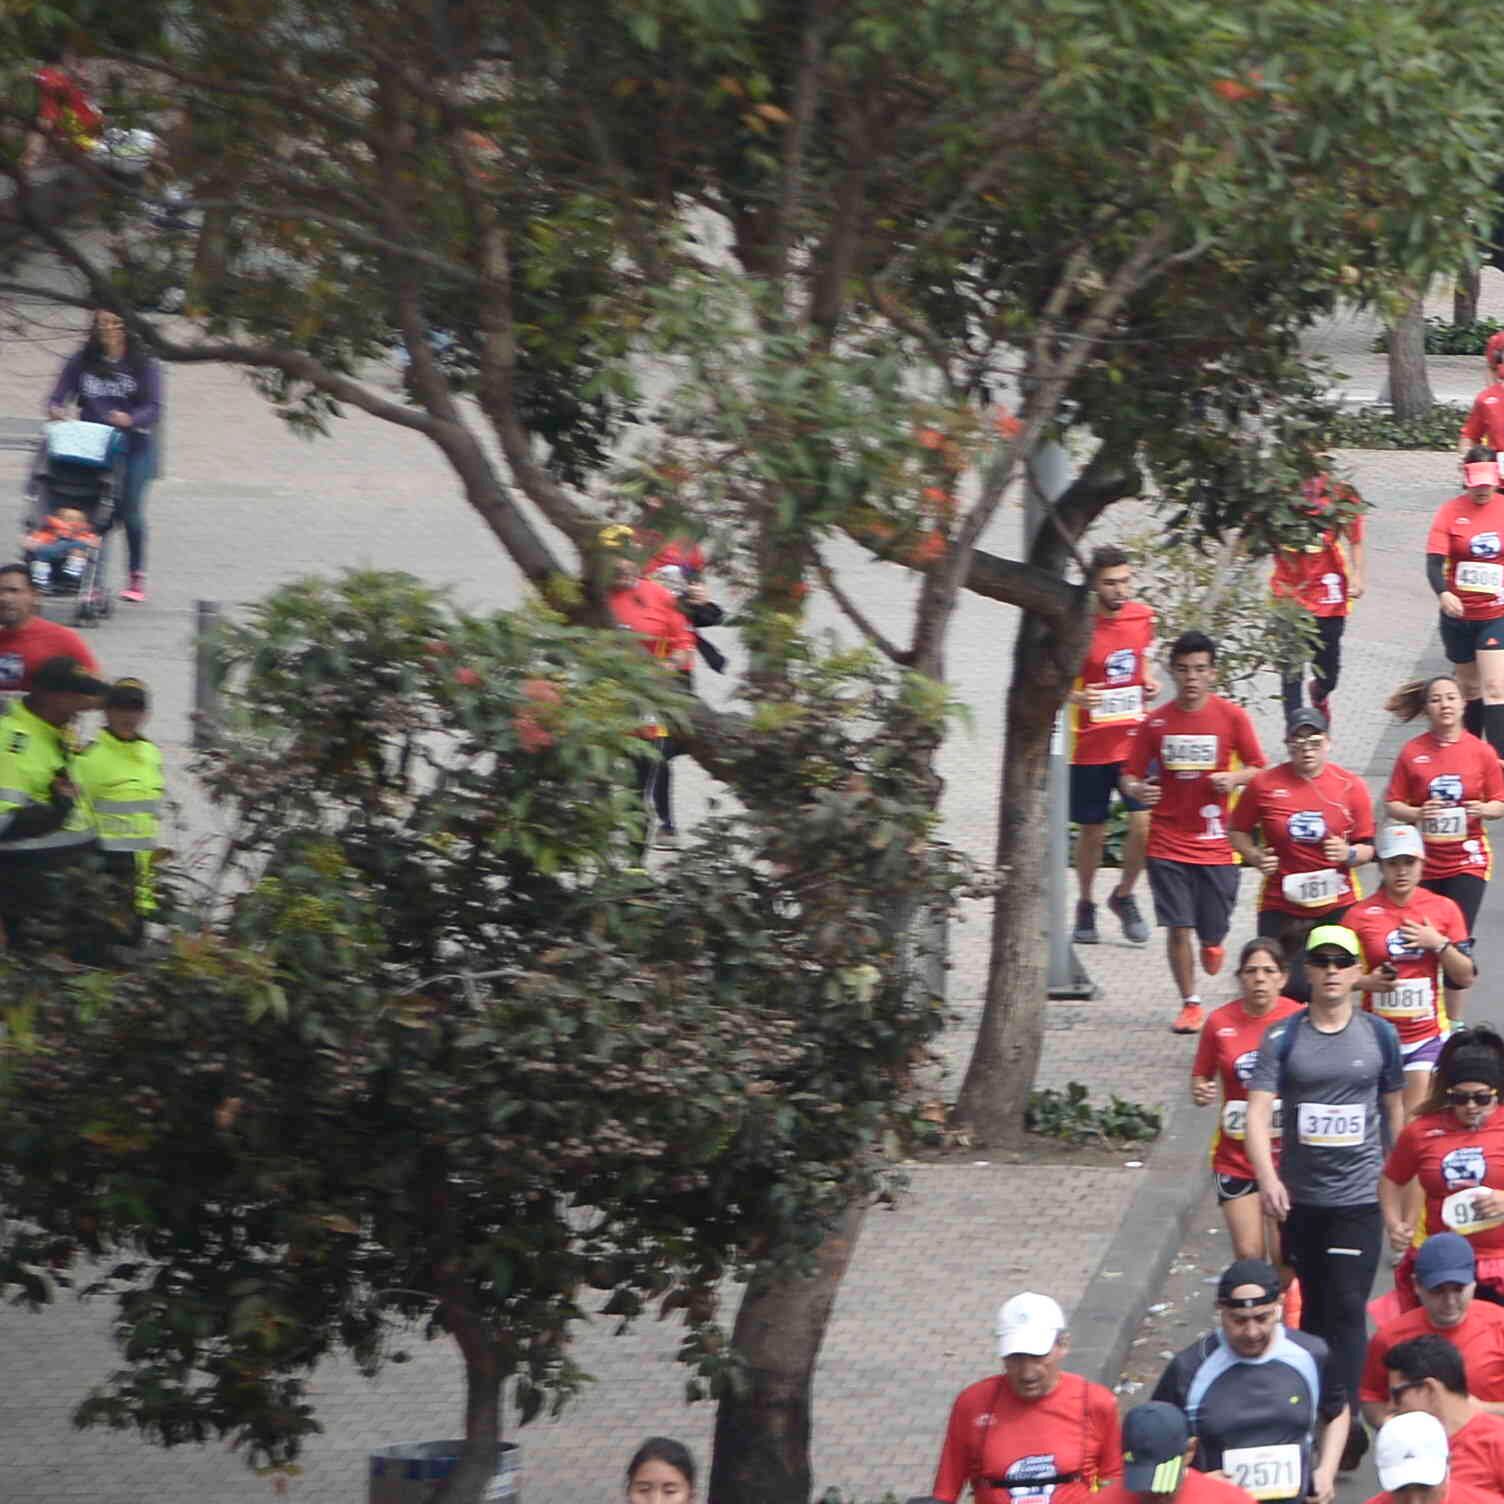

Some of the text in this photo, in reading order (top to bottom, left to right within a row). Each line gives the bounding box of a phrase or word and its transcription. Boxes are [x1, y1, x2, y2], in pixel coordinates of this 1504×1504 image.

[1300, 881, 1327, 900] 181
[1379, 988, 1424, 1008] 1081
[1307, 1115, 1361, 1134] 3705
[1235, 1459, 1295, 1489] 2571
